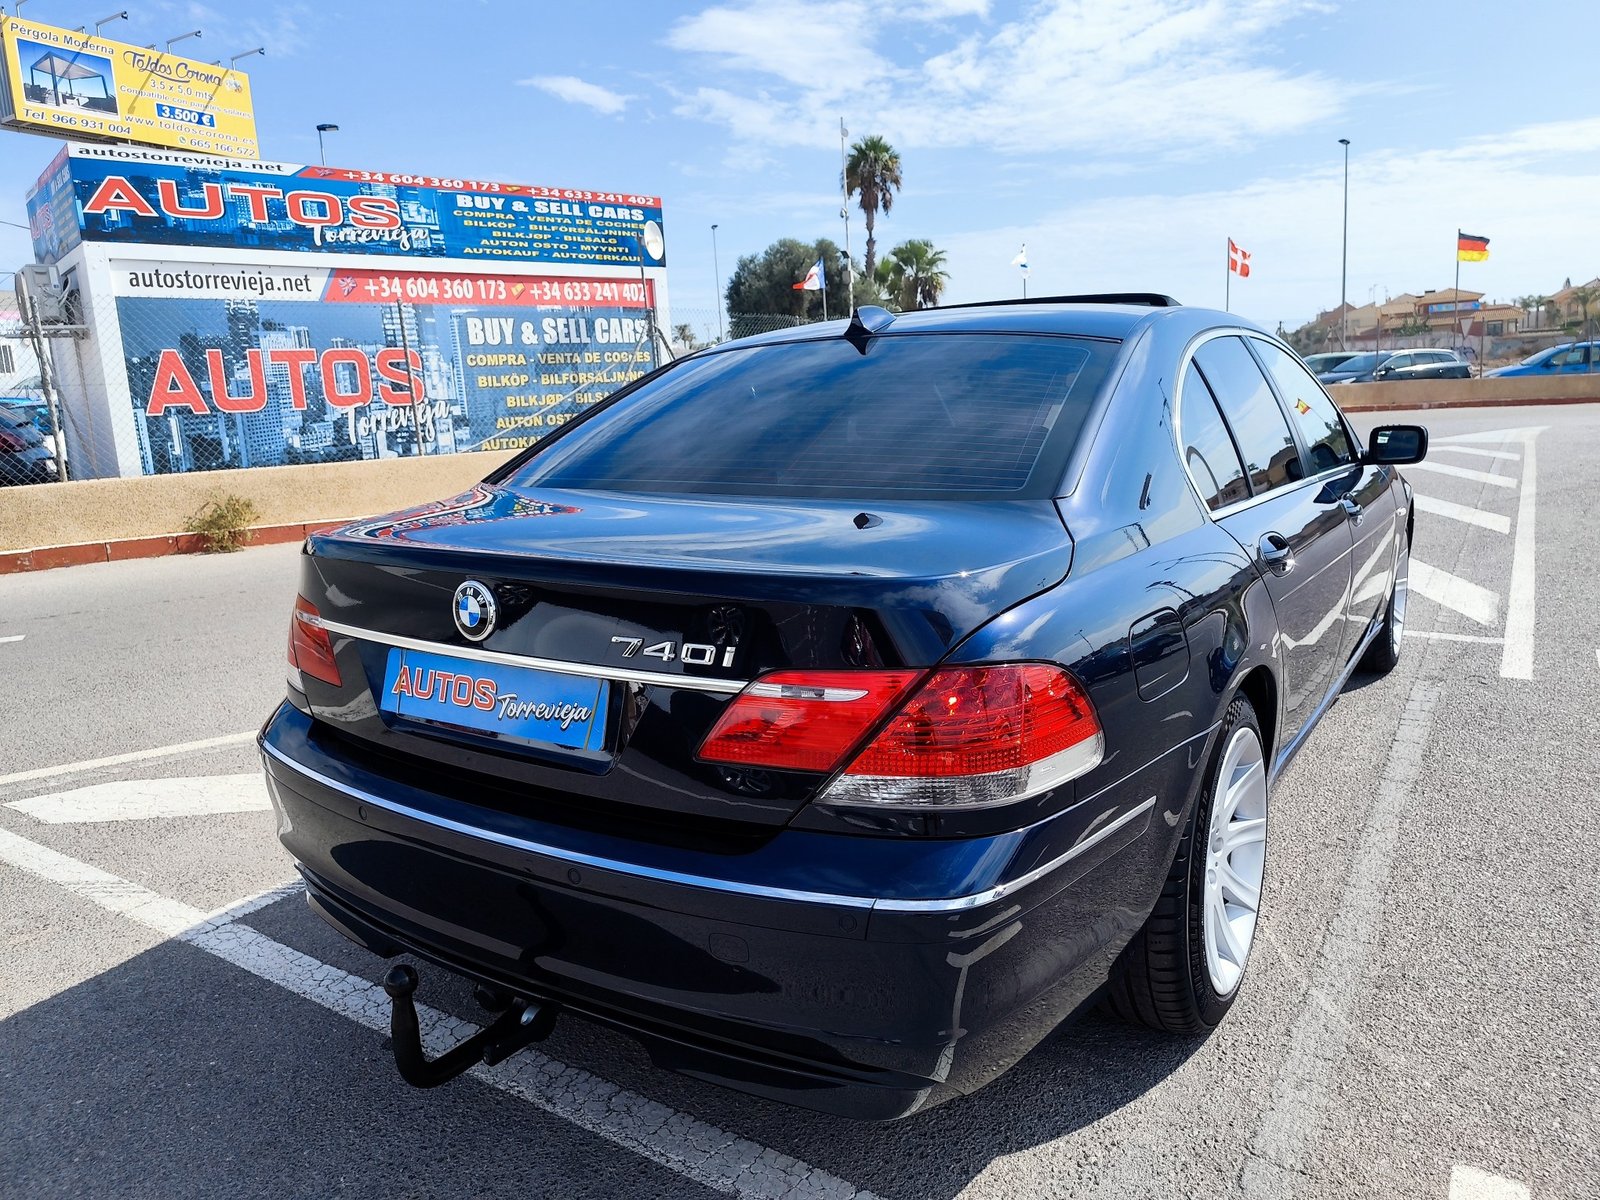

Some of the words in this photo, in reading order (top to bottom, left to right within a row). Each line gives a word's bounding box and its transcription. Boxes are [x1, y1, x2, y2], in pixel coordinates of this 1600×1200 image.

[10, 22, 59, 42] Pérgola
[63, 35, 114, 54] Moderna
[123, 50, 173, 77] Toldos
[176, 62, 222, 87] Corona
[120, 85, 170, 101] Compatible
[23, 108, 48, 120] Tel.
[52, 114, 77, 125] 966
[81, 119, 103, 130] 931
[108, 124, 131, 134] 004
[162, 106, 198, 123] 3.500
[201, 115, 211, 126] €
[78, 146, 283, 172] autostorrevieja.net
[190, 138, 211, 149] 665
[214, 142, 233, 153] 166
[236, 147, 255, 157] 572
[343, 170, 384, 182] +34
[389, 174, 425, 186] 604
[430, 177, 464, 189] 360
[469, 181, 500, 192] 173
[83, 176, 402, 231] AUTOS
[456, 194, 505, 210] BUY
[511, 201, 529, 212] &
[534, 201, 583, 217] SELL
[588, 205, 644, 221] CARS
[526, 187, 560, 197] +34
[564, 190, 592, 200] 633
[597, 193, 623, 203] 241
[628, 196, 654, 206] 402
[453, 210, 515, 220] COMPRA
[527, 215, 571, 225] VENTA
[596, 220, 646, 230] COCHES
[312, 223, 428, 251] Torrevieja
[481, 239, 529, 248] AUTON
[533, 242, 569, 250] OSTO
[580, 245, 629, 253] MYYNTI
[463, 247, 540, 256] AUTOKAUF
[128, 269, 312, 295] autostorrevieja.net
[365, 276, 402, 298] +34
[406, 277, 440, 299] 604
[442, 278, 474, 299] 360
[478, 279, 508, 300] 173
[530, 280, 560, 300] +34
[563, 281, 591, 301] 633
[595, 282, 619, 302] 241
[622, 282, 647, 302] 402
[466, 317, 514, 345] BUY
[520, 321, 538, 345] &
[542, 317, 591, 344] SELL
[594, 317, 649, 344] CARS
[466, 354, 526, 367] COMPRA
[537, 353, 581, 364] VENTA
[584, 352, 601, 363] DE
[146, 347, 425, 417] AUTOS
[345, 398, 451, 443] Torrevieja
[496, 415, 543, 429] AUTON
[546, 413, 579, 426] OST
[481, 436, 542, 451] AUTOKA
[457, 587, 486, 605] BMW
[611, 636, 736, 668] 740i
[392, 665, 498, 712] AUTOS
[496, 693, 592, 730] Torrevieja
